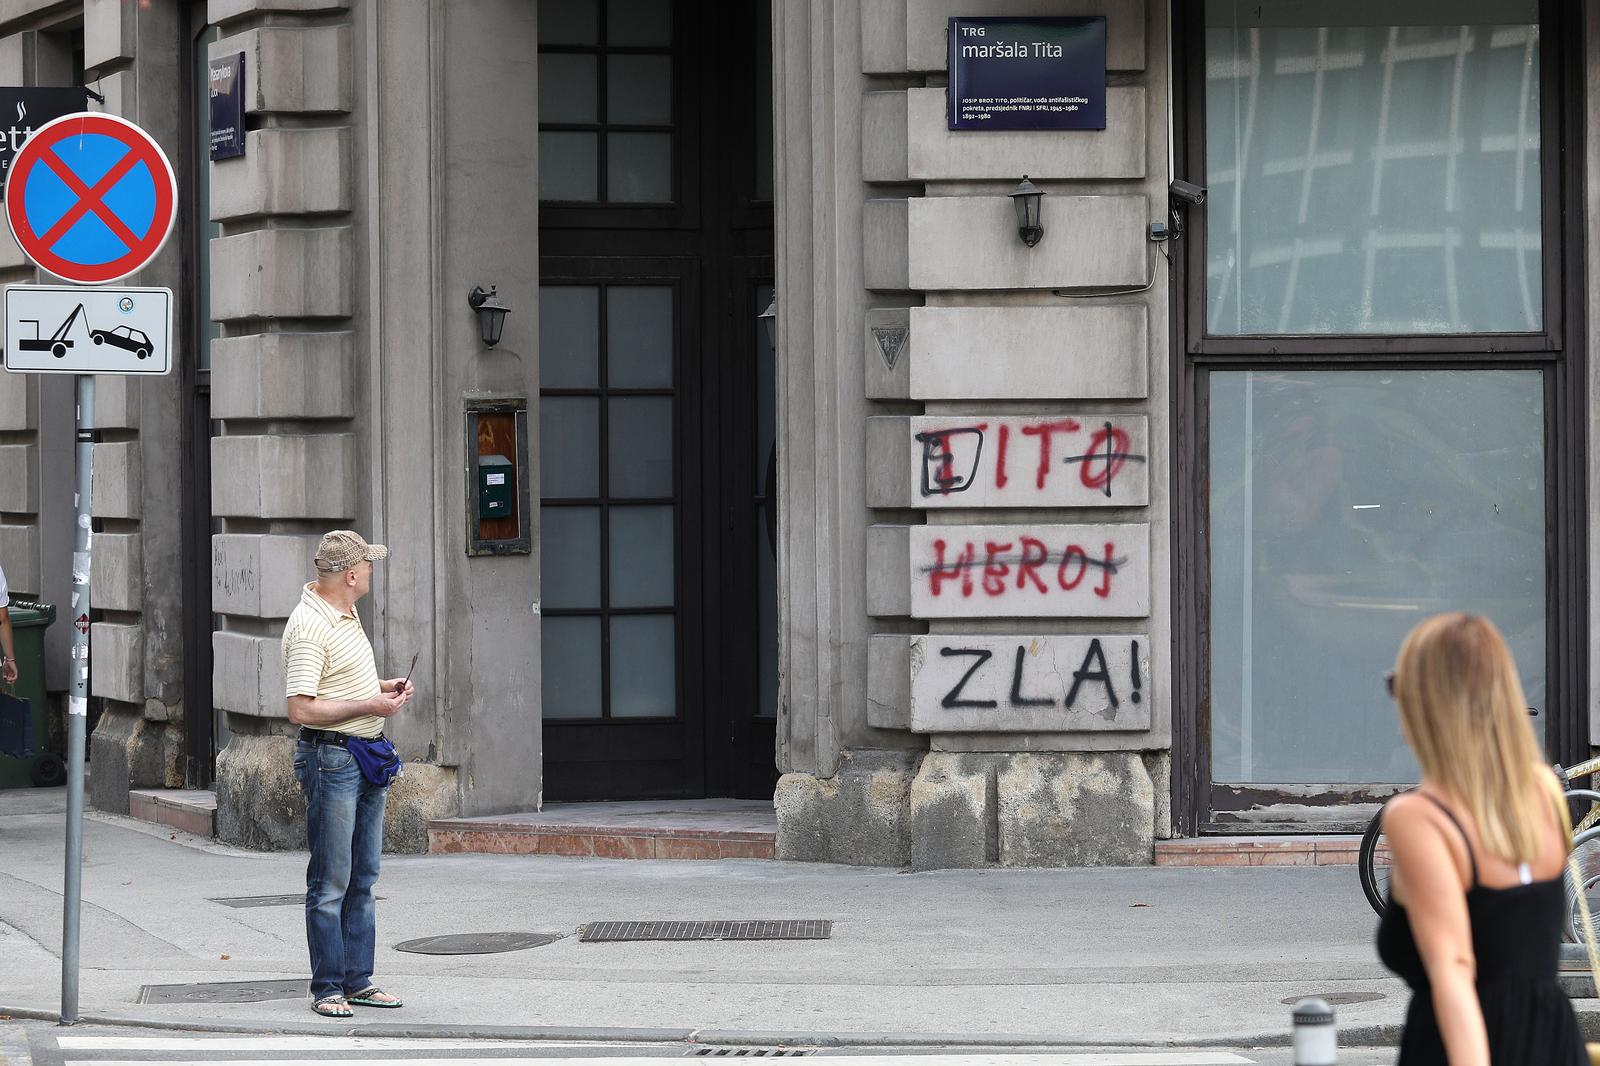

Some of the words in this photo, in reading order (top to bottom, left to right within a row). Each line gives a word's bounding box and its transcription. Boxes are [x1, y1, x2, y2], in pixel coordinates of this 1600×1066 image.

[962, 27, 986, 37] TRG
[962, 41, 1028, 58] maršala
[1032, 42, 1063, 58] Tita
[928, 536, 1116, 598] HEROJ
[940, 638, 1142, 709] ZLA!
